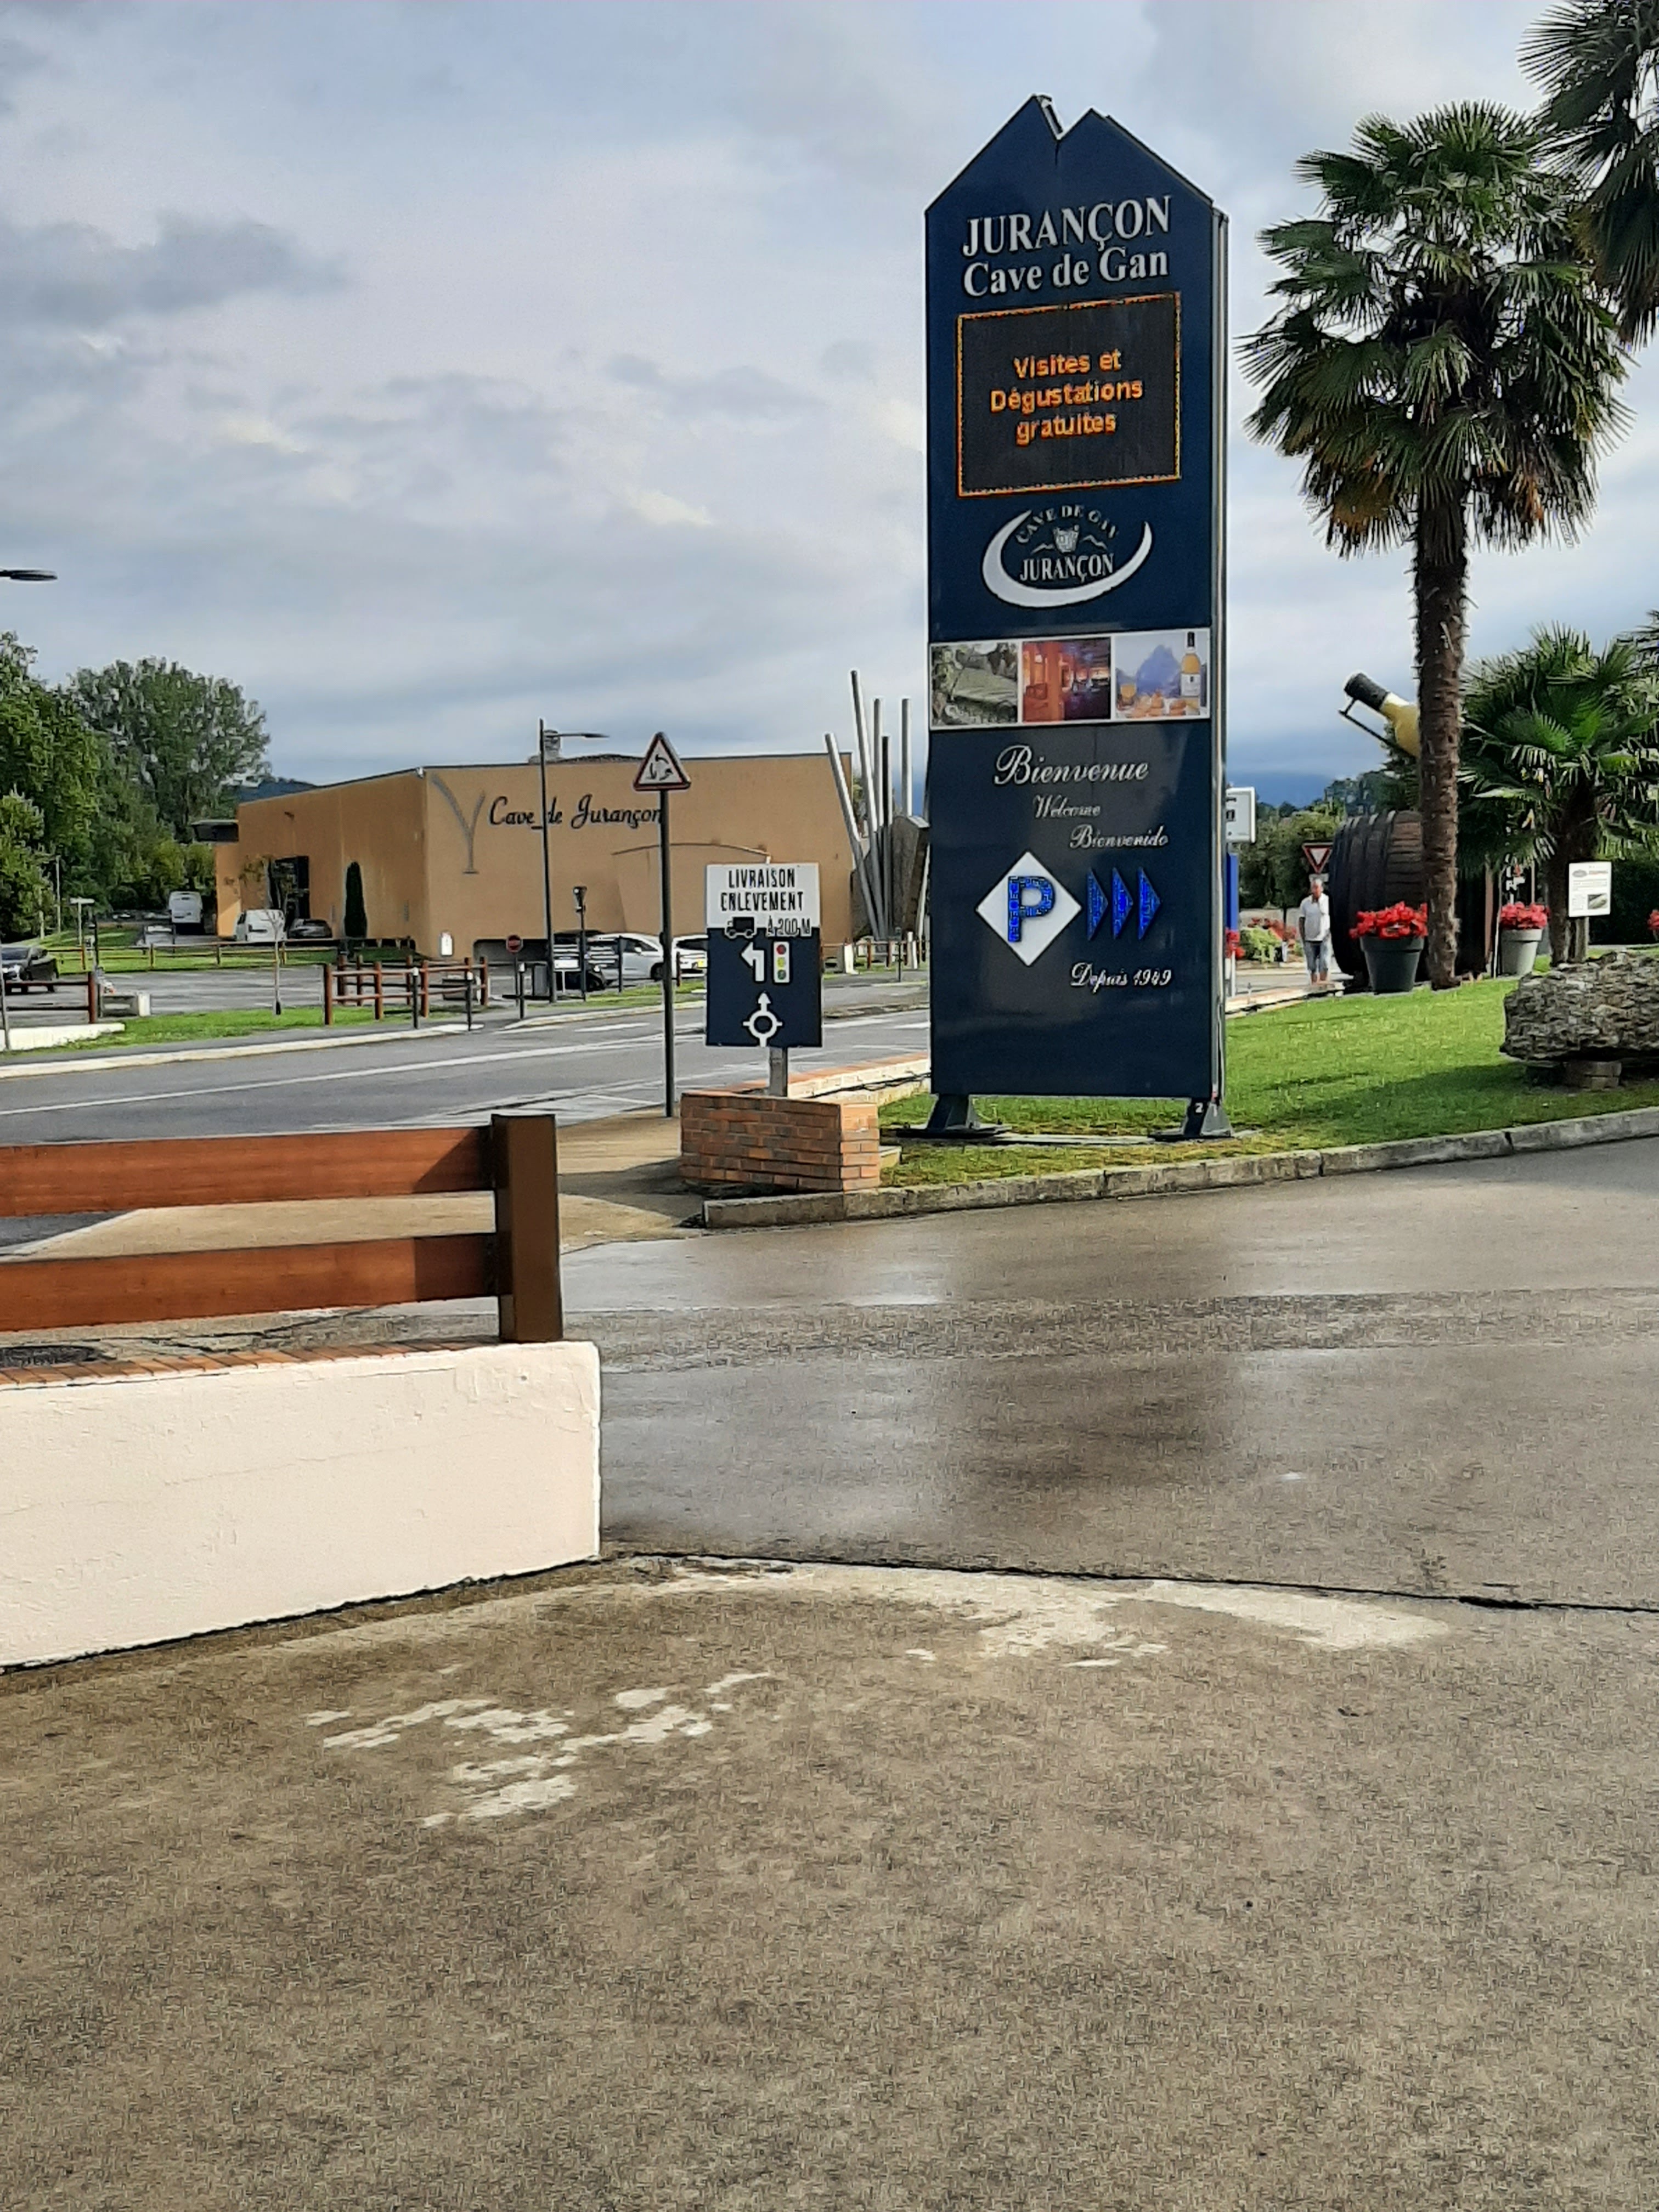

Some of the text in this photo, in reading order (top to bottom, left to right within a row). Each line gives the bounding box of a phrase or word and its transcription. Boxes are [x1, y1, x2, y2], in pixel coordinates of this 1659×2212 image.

[962, 195, 1170, 257] JURANÇON
[964, 246, 1169, 297] Cave de Gan
[1014, 348, 1121, 379] Visites et
[990, 379, 1143, 414] Dégustations
[1015, 413, 1116, 447] gratuites
[1062, 505, 1085, 517] DE
[1020, 553, 1114, 583] JURANÇON
[994, 744, 1149, 785] Bienvenue
[490, 796, 535, 825] Cave
[549, 797, 562, 823] de
[1032, 794, 1101, 818] Welcome
[1070, 825, 1169, 848] Bienvenido
[729, 869, 795, 888] LIVRAISON
[720, 891, 804, 911] ENLEVEMENT
[1008, 876, 1056, 943] P
[778, 918, 798, 935] 200
[802, 918, 810, 934] M
[1070, 962, 1128, 994] Depuis
